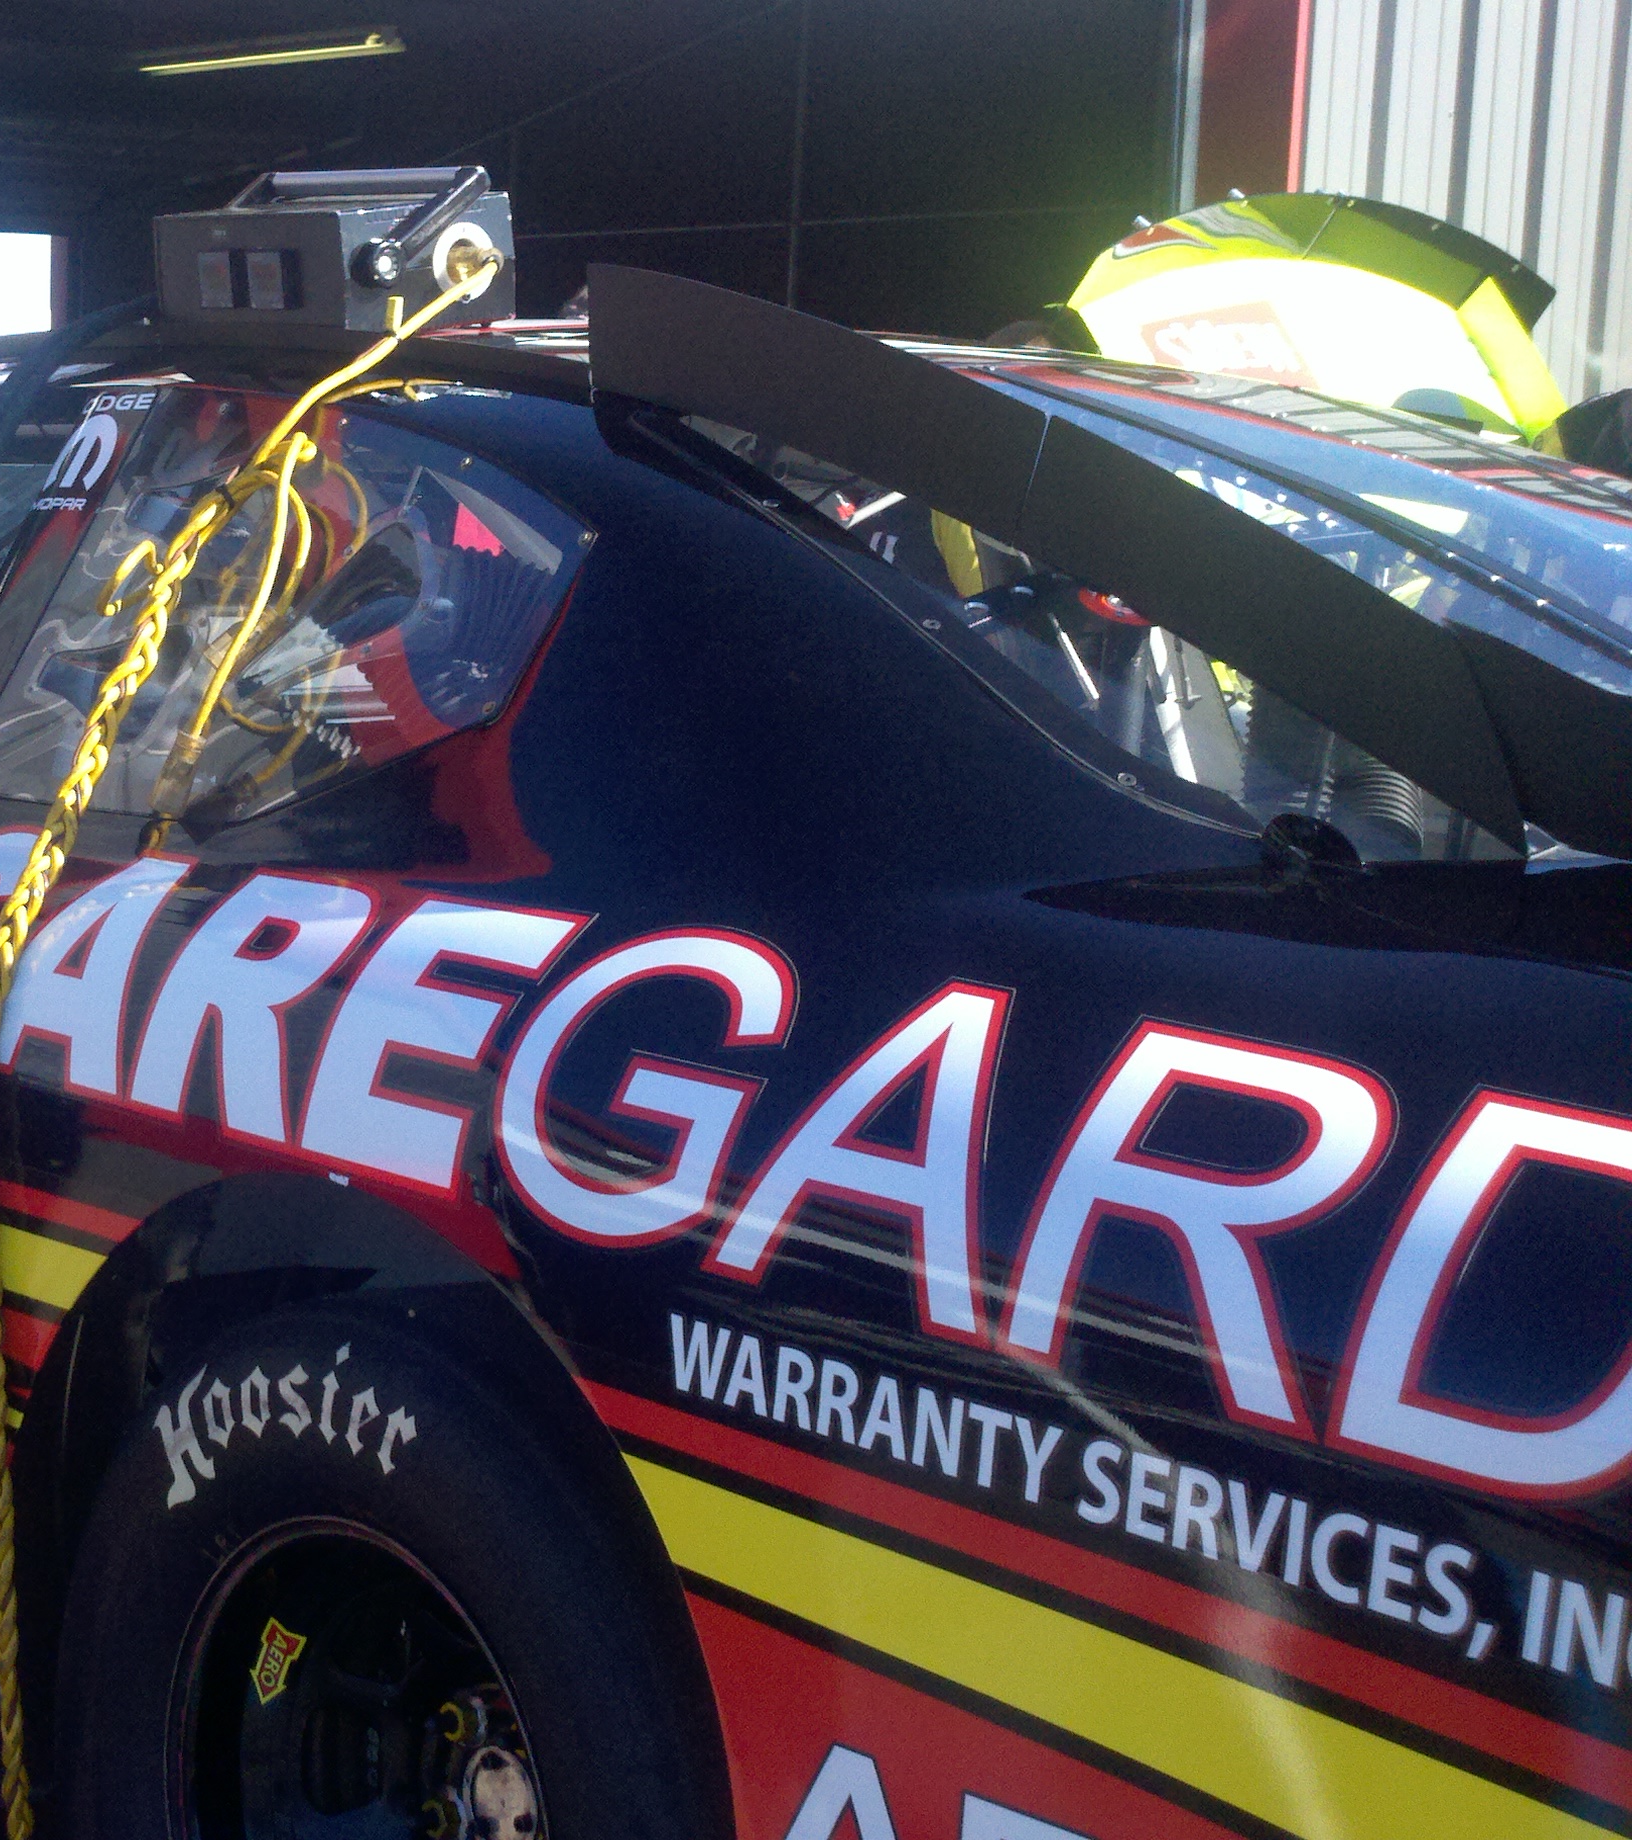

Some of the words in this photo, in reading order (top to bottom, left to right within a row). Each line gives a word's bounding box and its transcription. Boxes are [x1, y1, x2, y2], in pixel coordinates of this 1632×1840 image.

[154, 1340, 418, 1510] Hoosier
[668, 1312, 1064, 1504] WARRANTY
[1076, 1440, 1496, 1660] SERVICES,
[1522, 1569, 1632, 1688] IN
[260, 1631, 288, 1688] AERO
